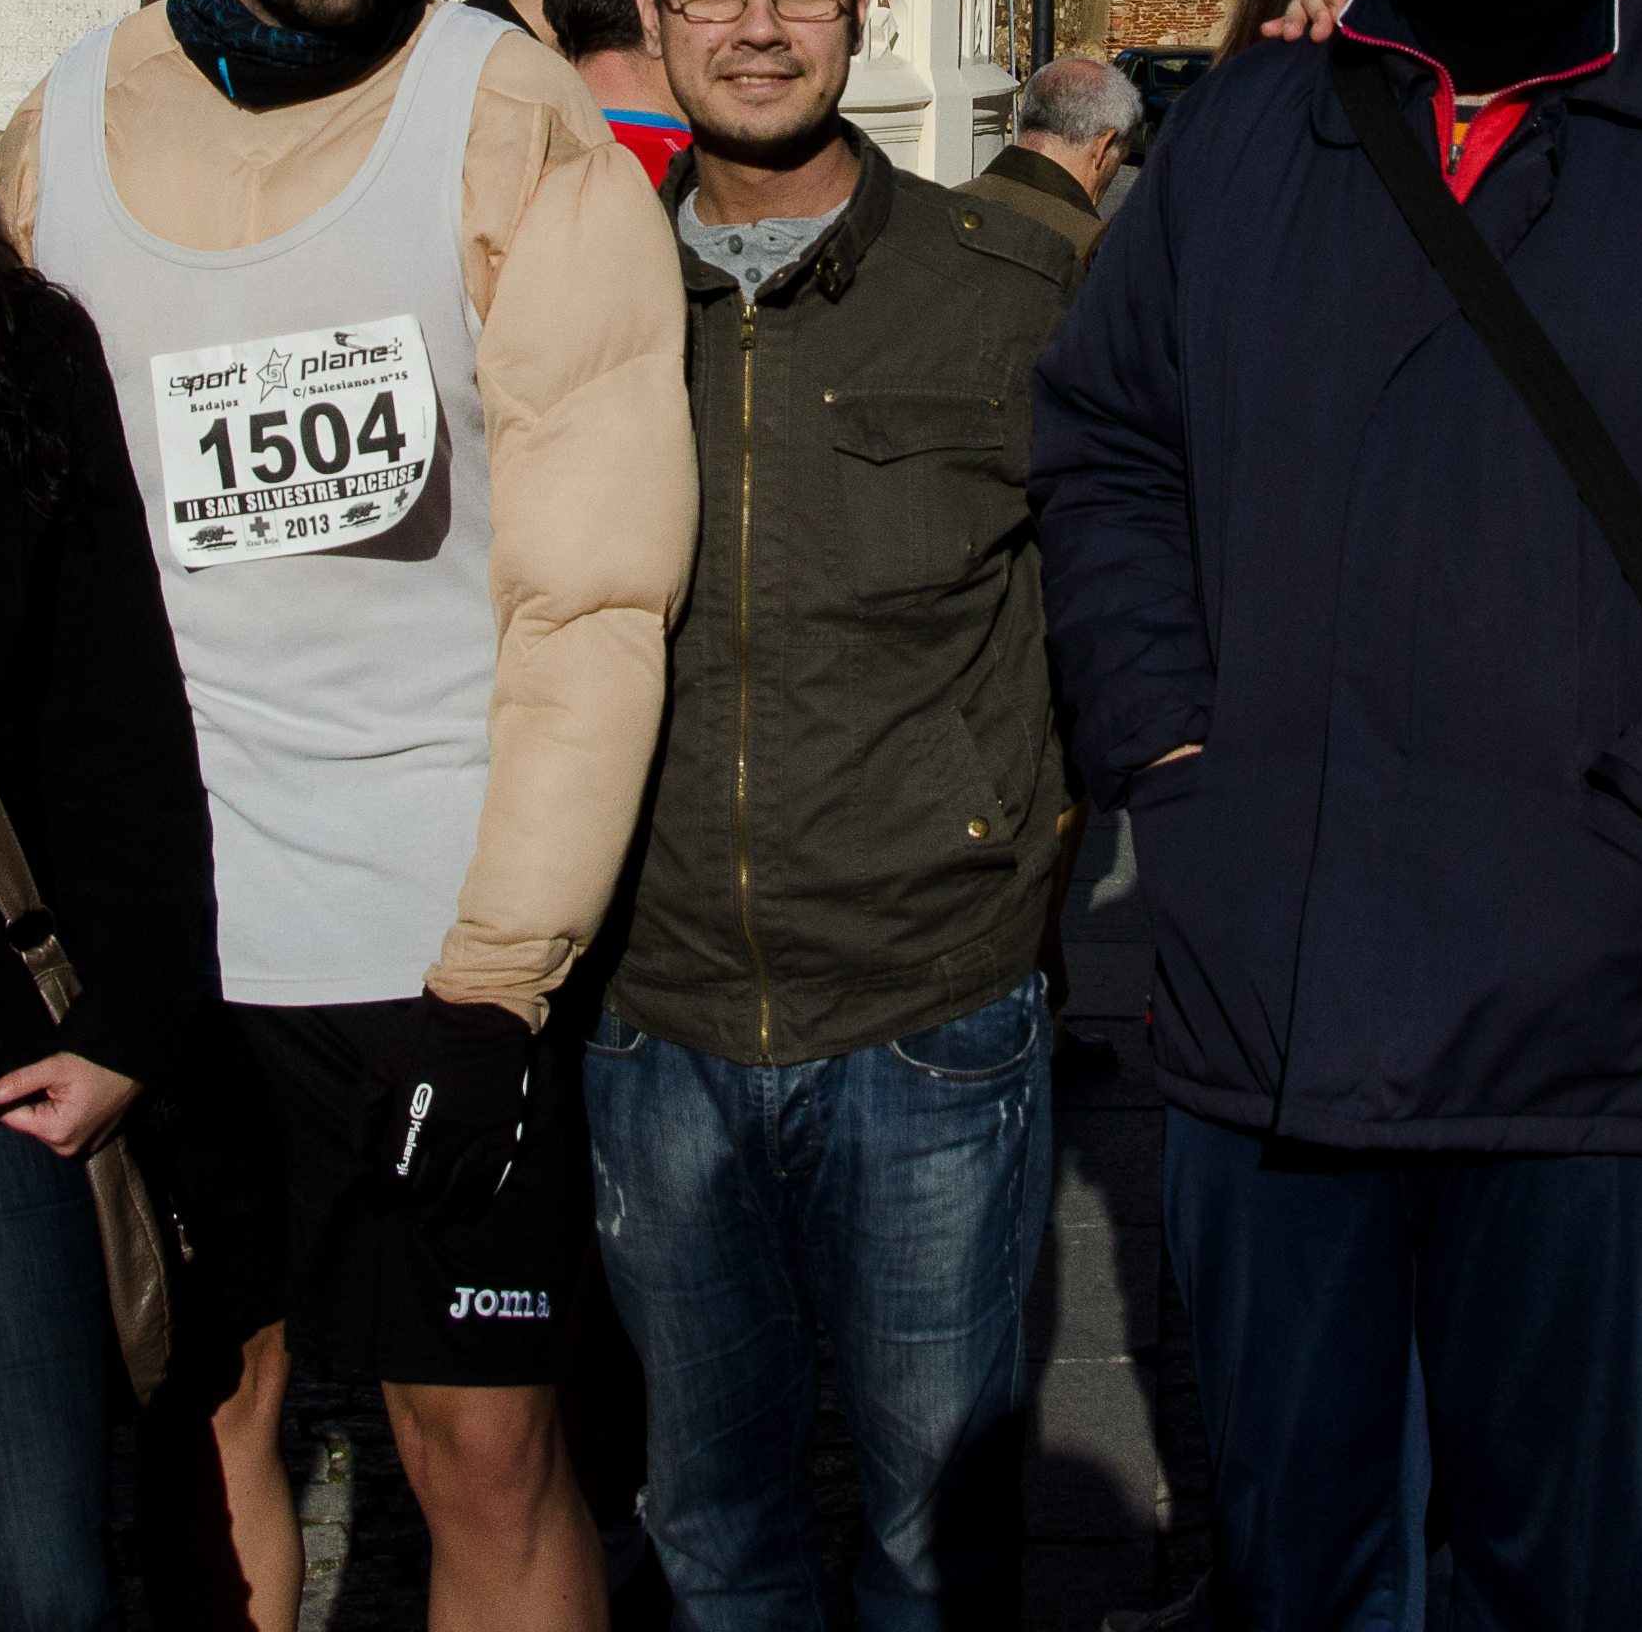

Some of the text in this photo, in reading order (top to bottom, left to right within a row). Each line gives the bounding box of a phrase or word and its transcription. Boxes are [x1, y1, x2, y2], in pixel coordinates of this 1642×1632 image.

[293, 376, 375, 399] C/Salesianos
[190, 399, 239, 413] Badajoz
[199, 390, 406, 490] 1504
[186, 502, 199, 520] II
[205, 495, 240, 518] SAN
[246, 480, 340, 513] SILVESTRE
[345, 464, 417, 498] PACENSE
[285, 514, 330, 540] 2013
